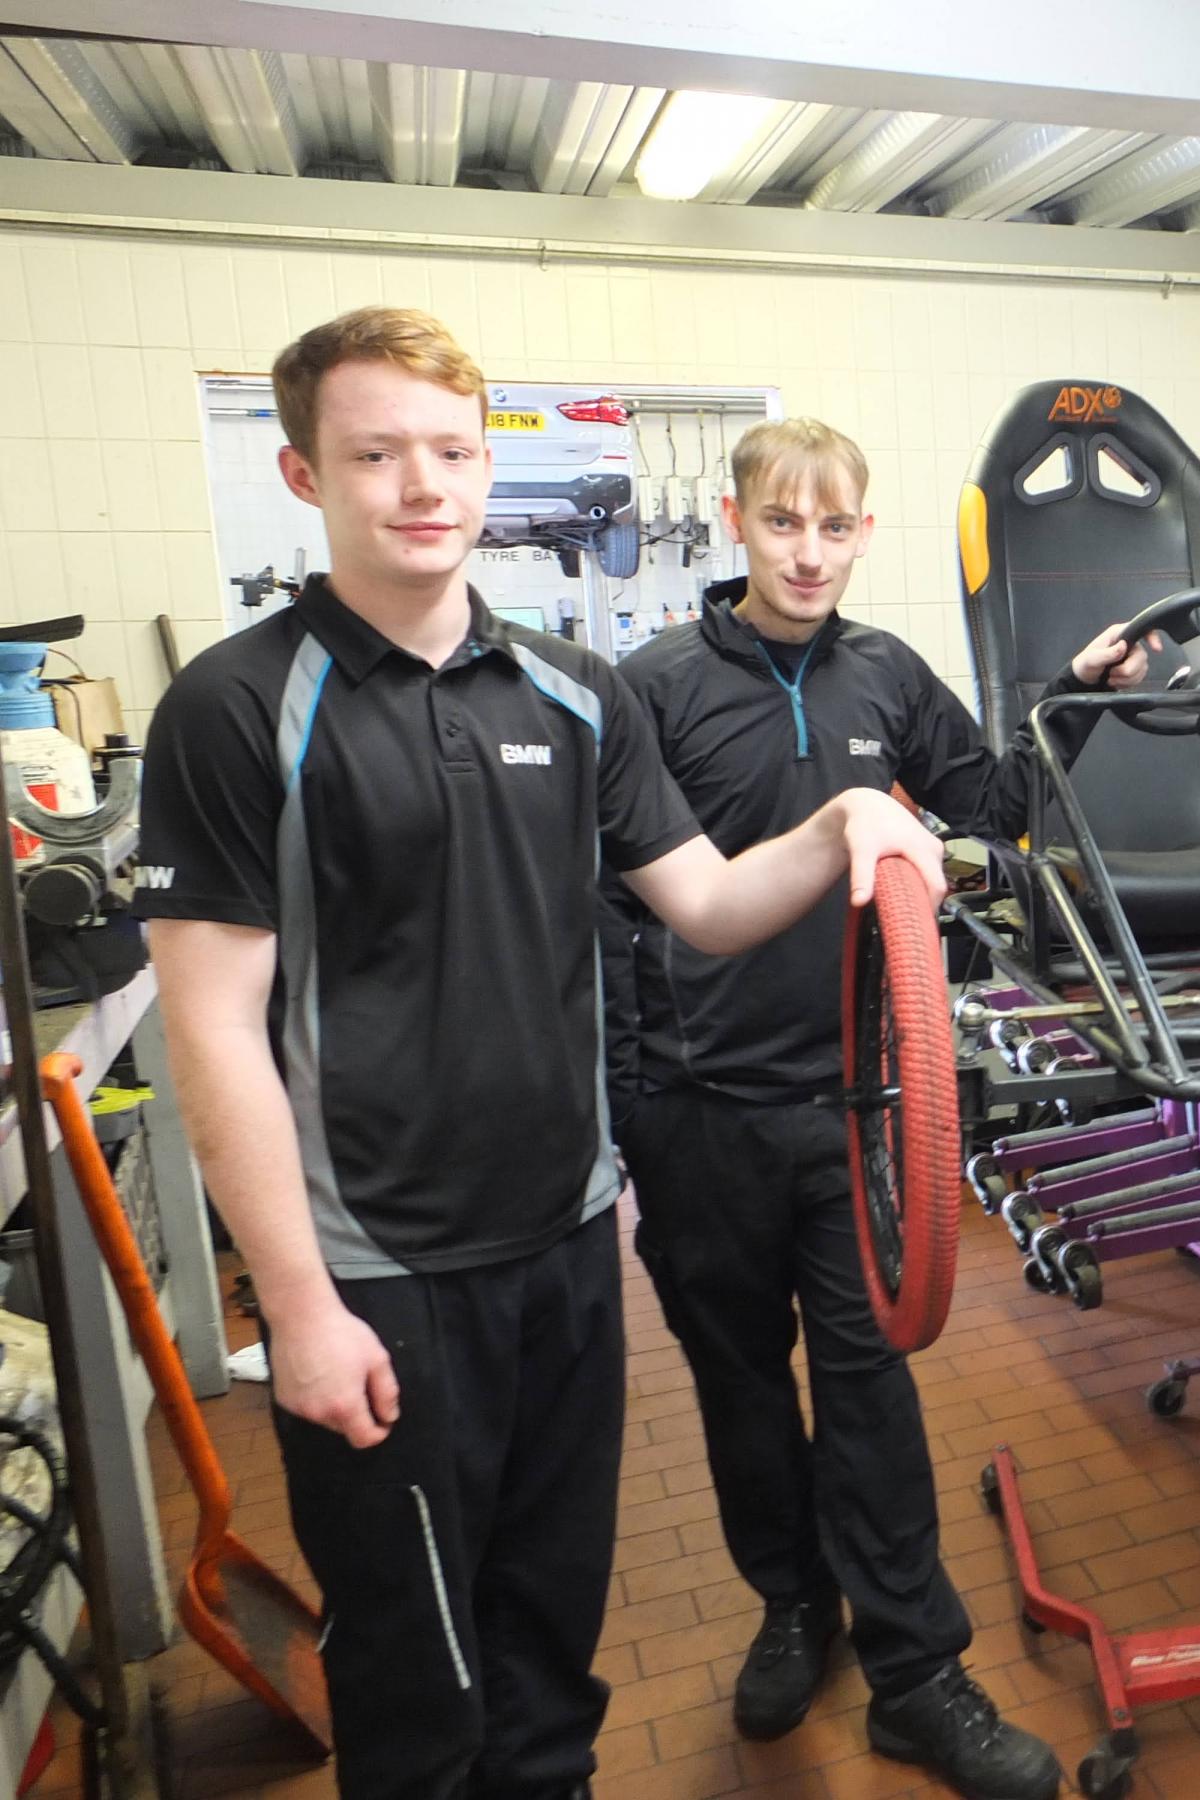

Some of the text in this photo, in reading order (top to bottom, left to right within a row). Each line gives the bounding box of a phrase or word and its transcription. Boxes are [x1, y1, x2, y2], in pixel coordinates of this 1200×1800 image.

[1048, 387, 1104, 422] ADX
[486, 414, 539, 428] 18 FNW
[480, 550, 554, 562] TYRE BA
[500, 744, 552, 765] BMW
